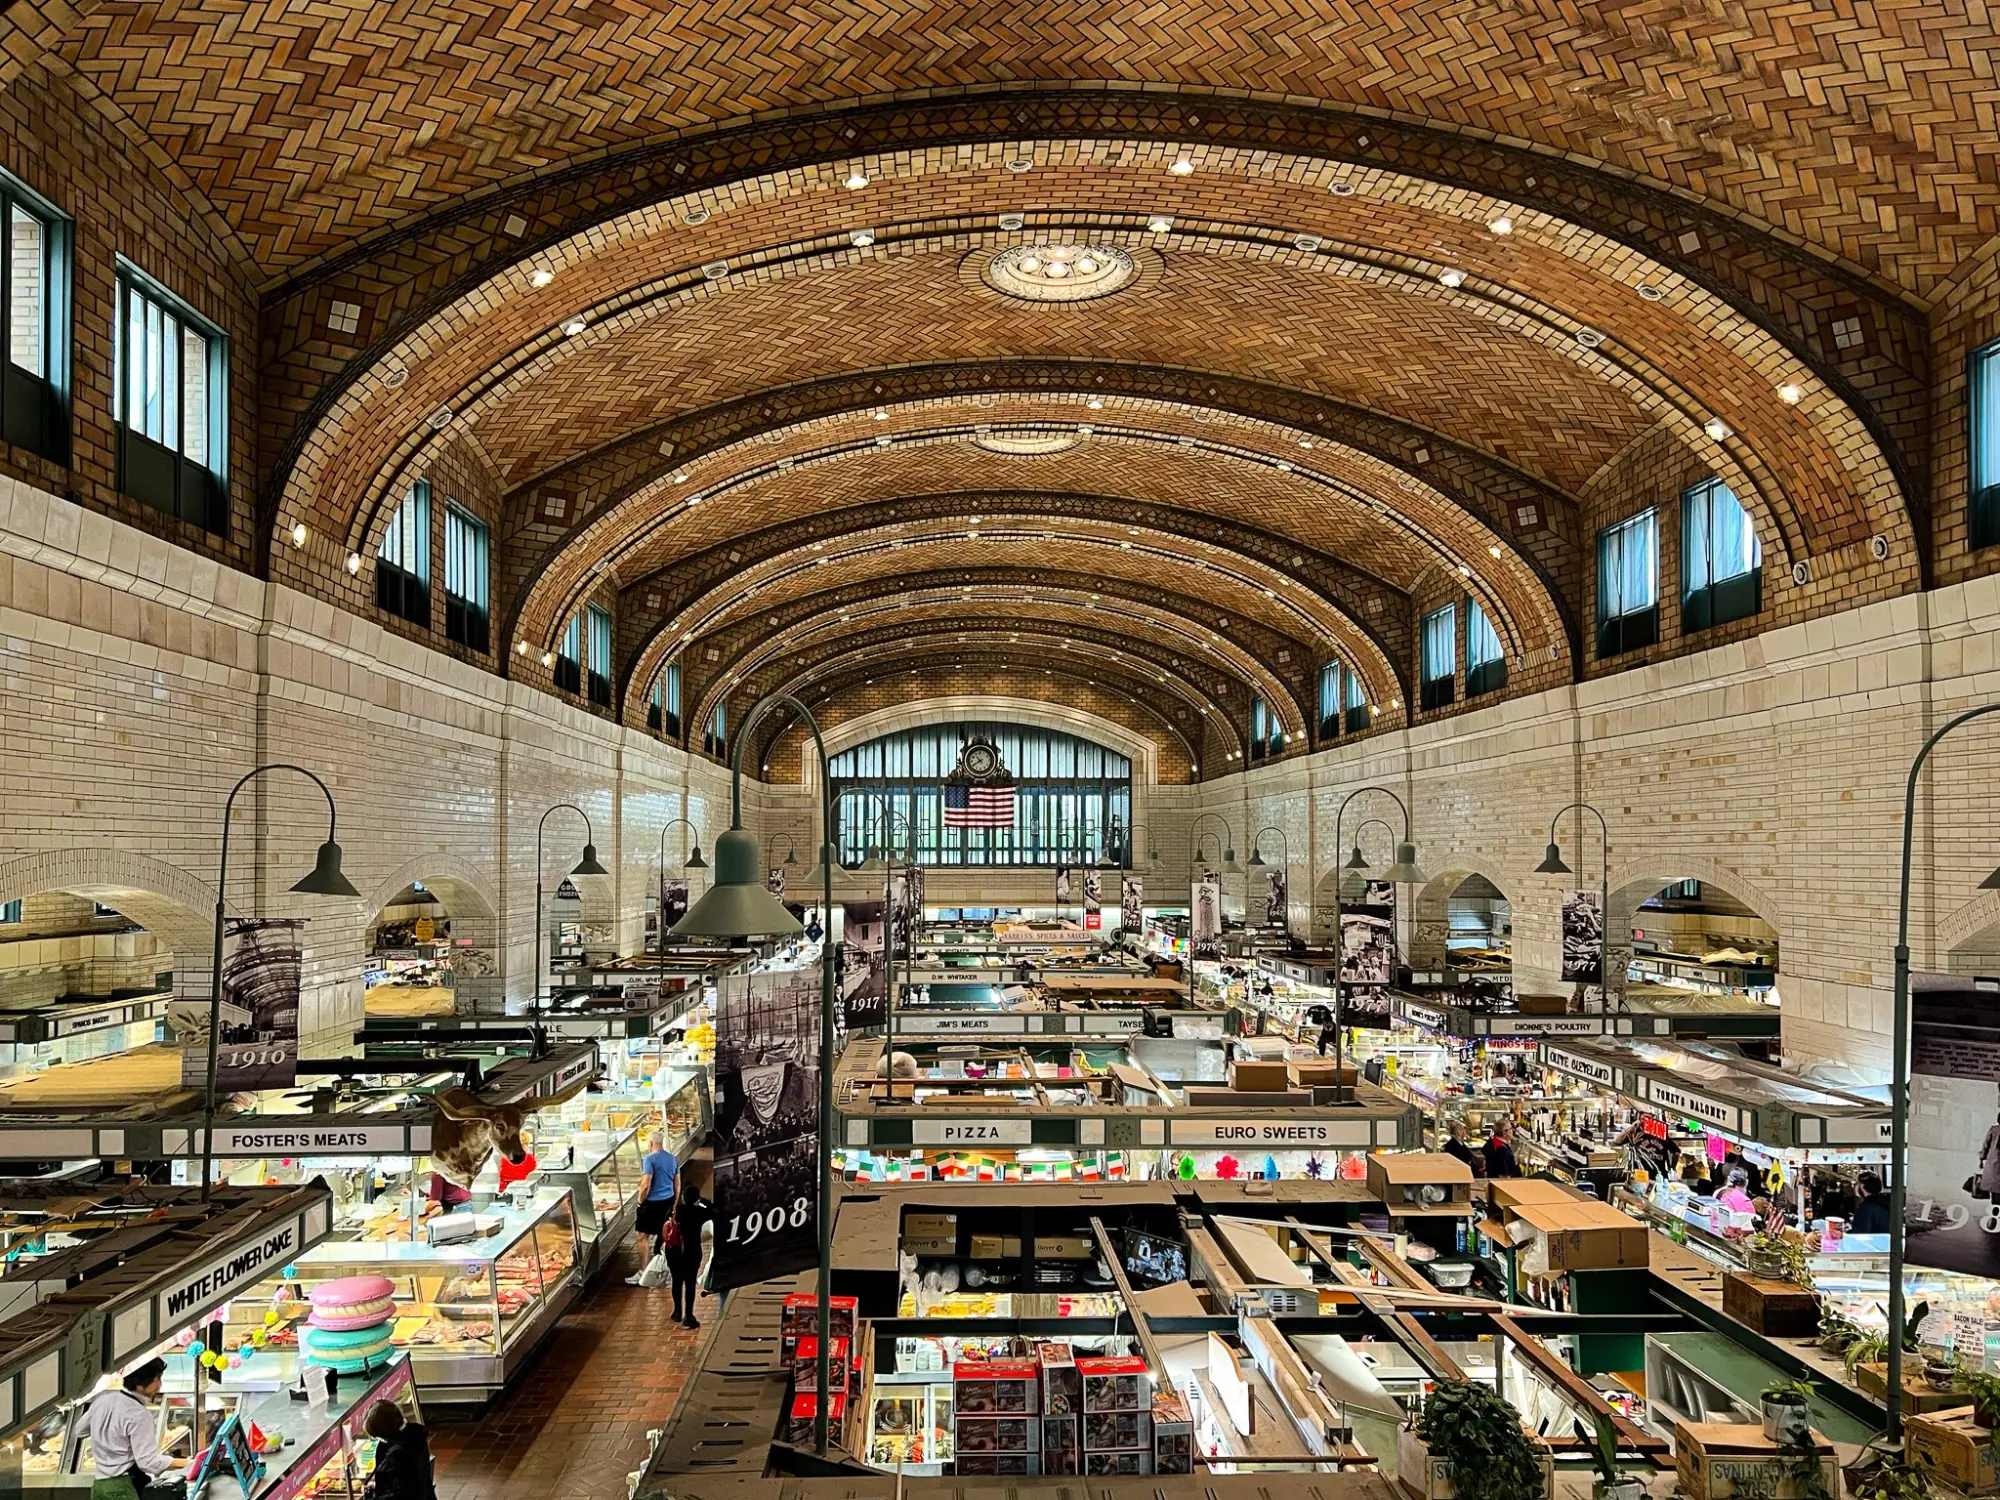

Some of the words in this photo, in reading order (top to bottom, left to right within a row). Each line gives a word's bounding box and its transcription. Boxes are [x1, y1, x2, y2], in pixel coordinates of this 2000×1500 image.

[1569, 961, 1597, 972] 1977
[850, 996, 880, 1012] 1917
[961, 1020, 989, 1028] MEATS
[1514, 1023, 1552, 1031] DIONNE'S
[1555, 1023, 1591, 1031] POULTRY
[228, 1050, 286, 1069] 1910
[1689, 1099, 1727, 1121] BALONEY
[945, 1127, 999, 1138] PIZZA
[1215, 1127, 1256, 1139] EURO
[1263, 1127, 1327, 1139] SWEETS
[232, 1135, 310, 1148] FOSTER'S
[314, 1133, 367, 1146] MEATS
[726, 1197, 808, 1246] 1908
[167, 1274, 212, 1317] WHITE
[212, 1246, 263, 1291] FLOWER
[263, 1227, 293, 1260] CAKE
